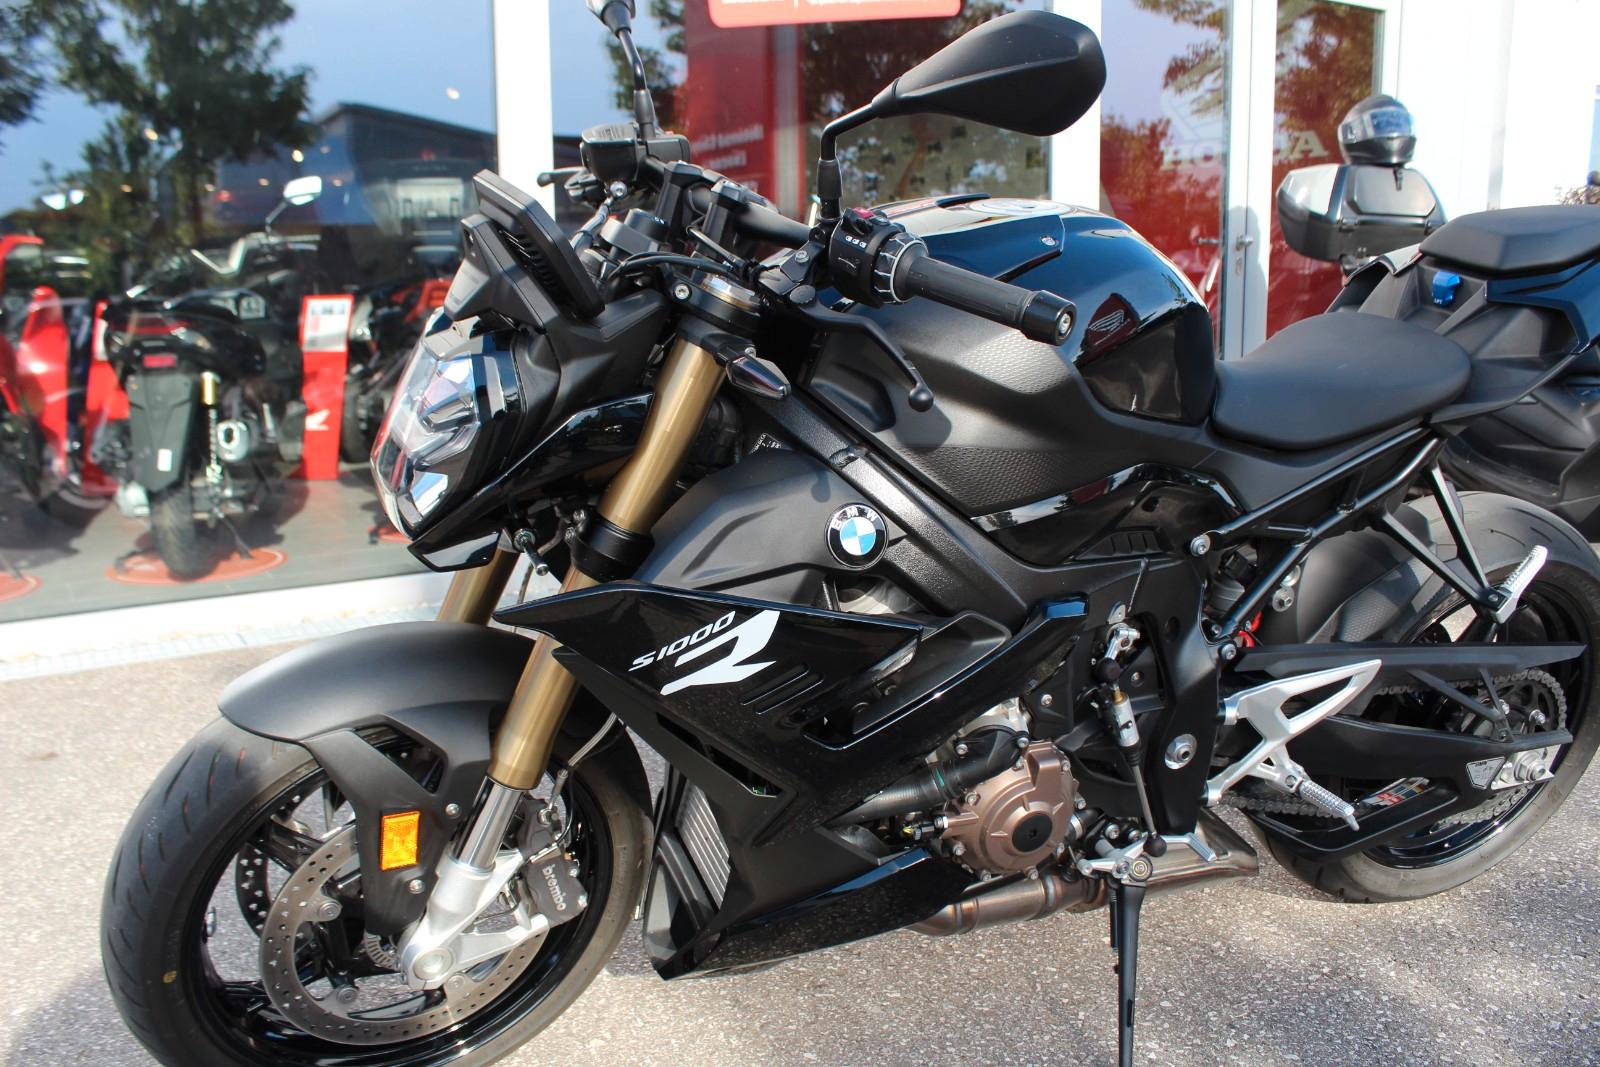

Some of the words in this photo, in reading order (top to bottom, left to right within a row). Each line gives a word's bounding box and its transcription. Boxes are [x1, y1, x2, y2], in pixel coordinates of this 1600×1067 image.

[830, 505, 879, 531] BMW
[628, 610, 736, 671] S1000
[660, 609, 780, 696] R
[542, 863, 567, 911] brembo
